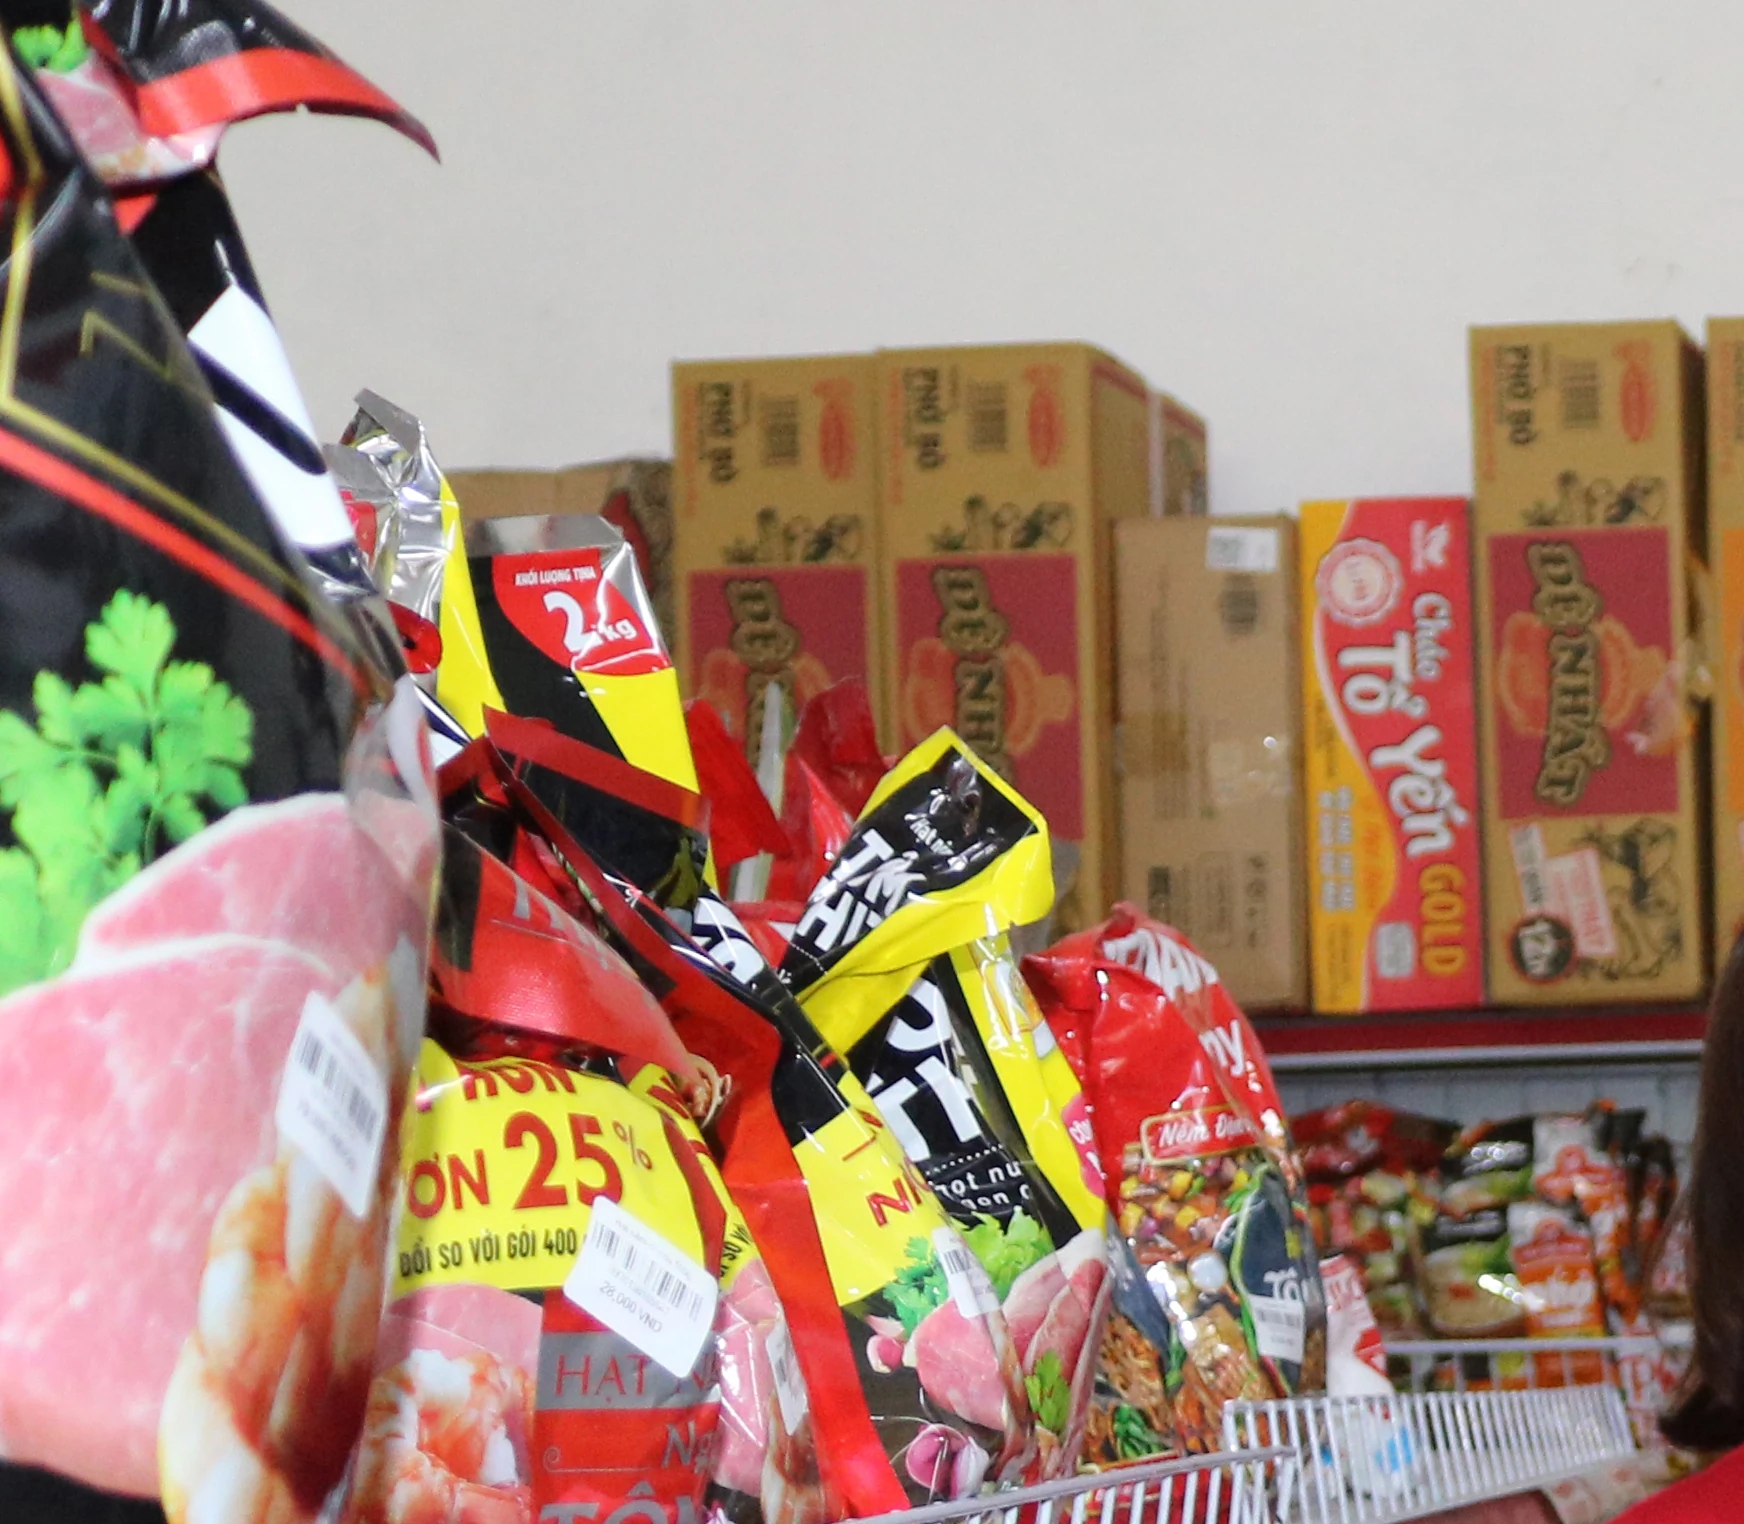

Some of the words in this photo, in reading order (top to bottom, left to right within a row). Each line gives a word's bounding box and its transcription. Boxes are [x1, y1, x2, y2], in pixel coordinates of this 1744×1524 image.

[1367, 724, 1470, 860] Yến
[1418, 862, 1467, 977] GOLD
[438, 1241, 463, 1270] SO
[471, 1226, 501, 1264] VỚI
[507, 1225, 537, 1258] GÓI
[544, 1227, 577, 1257] 400
[555, 1353, 652, 1404] HẠT
